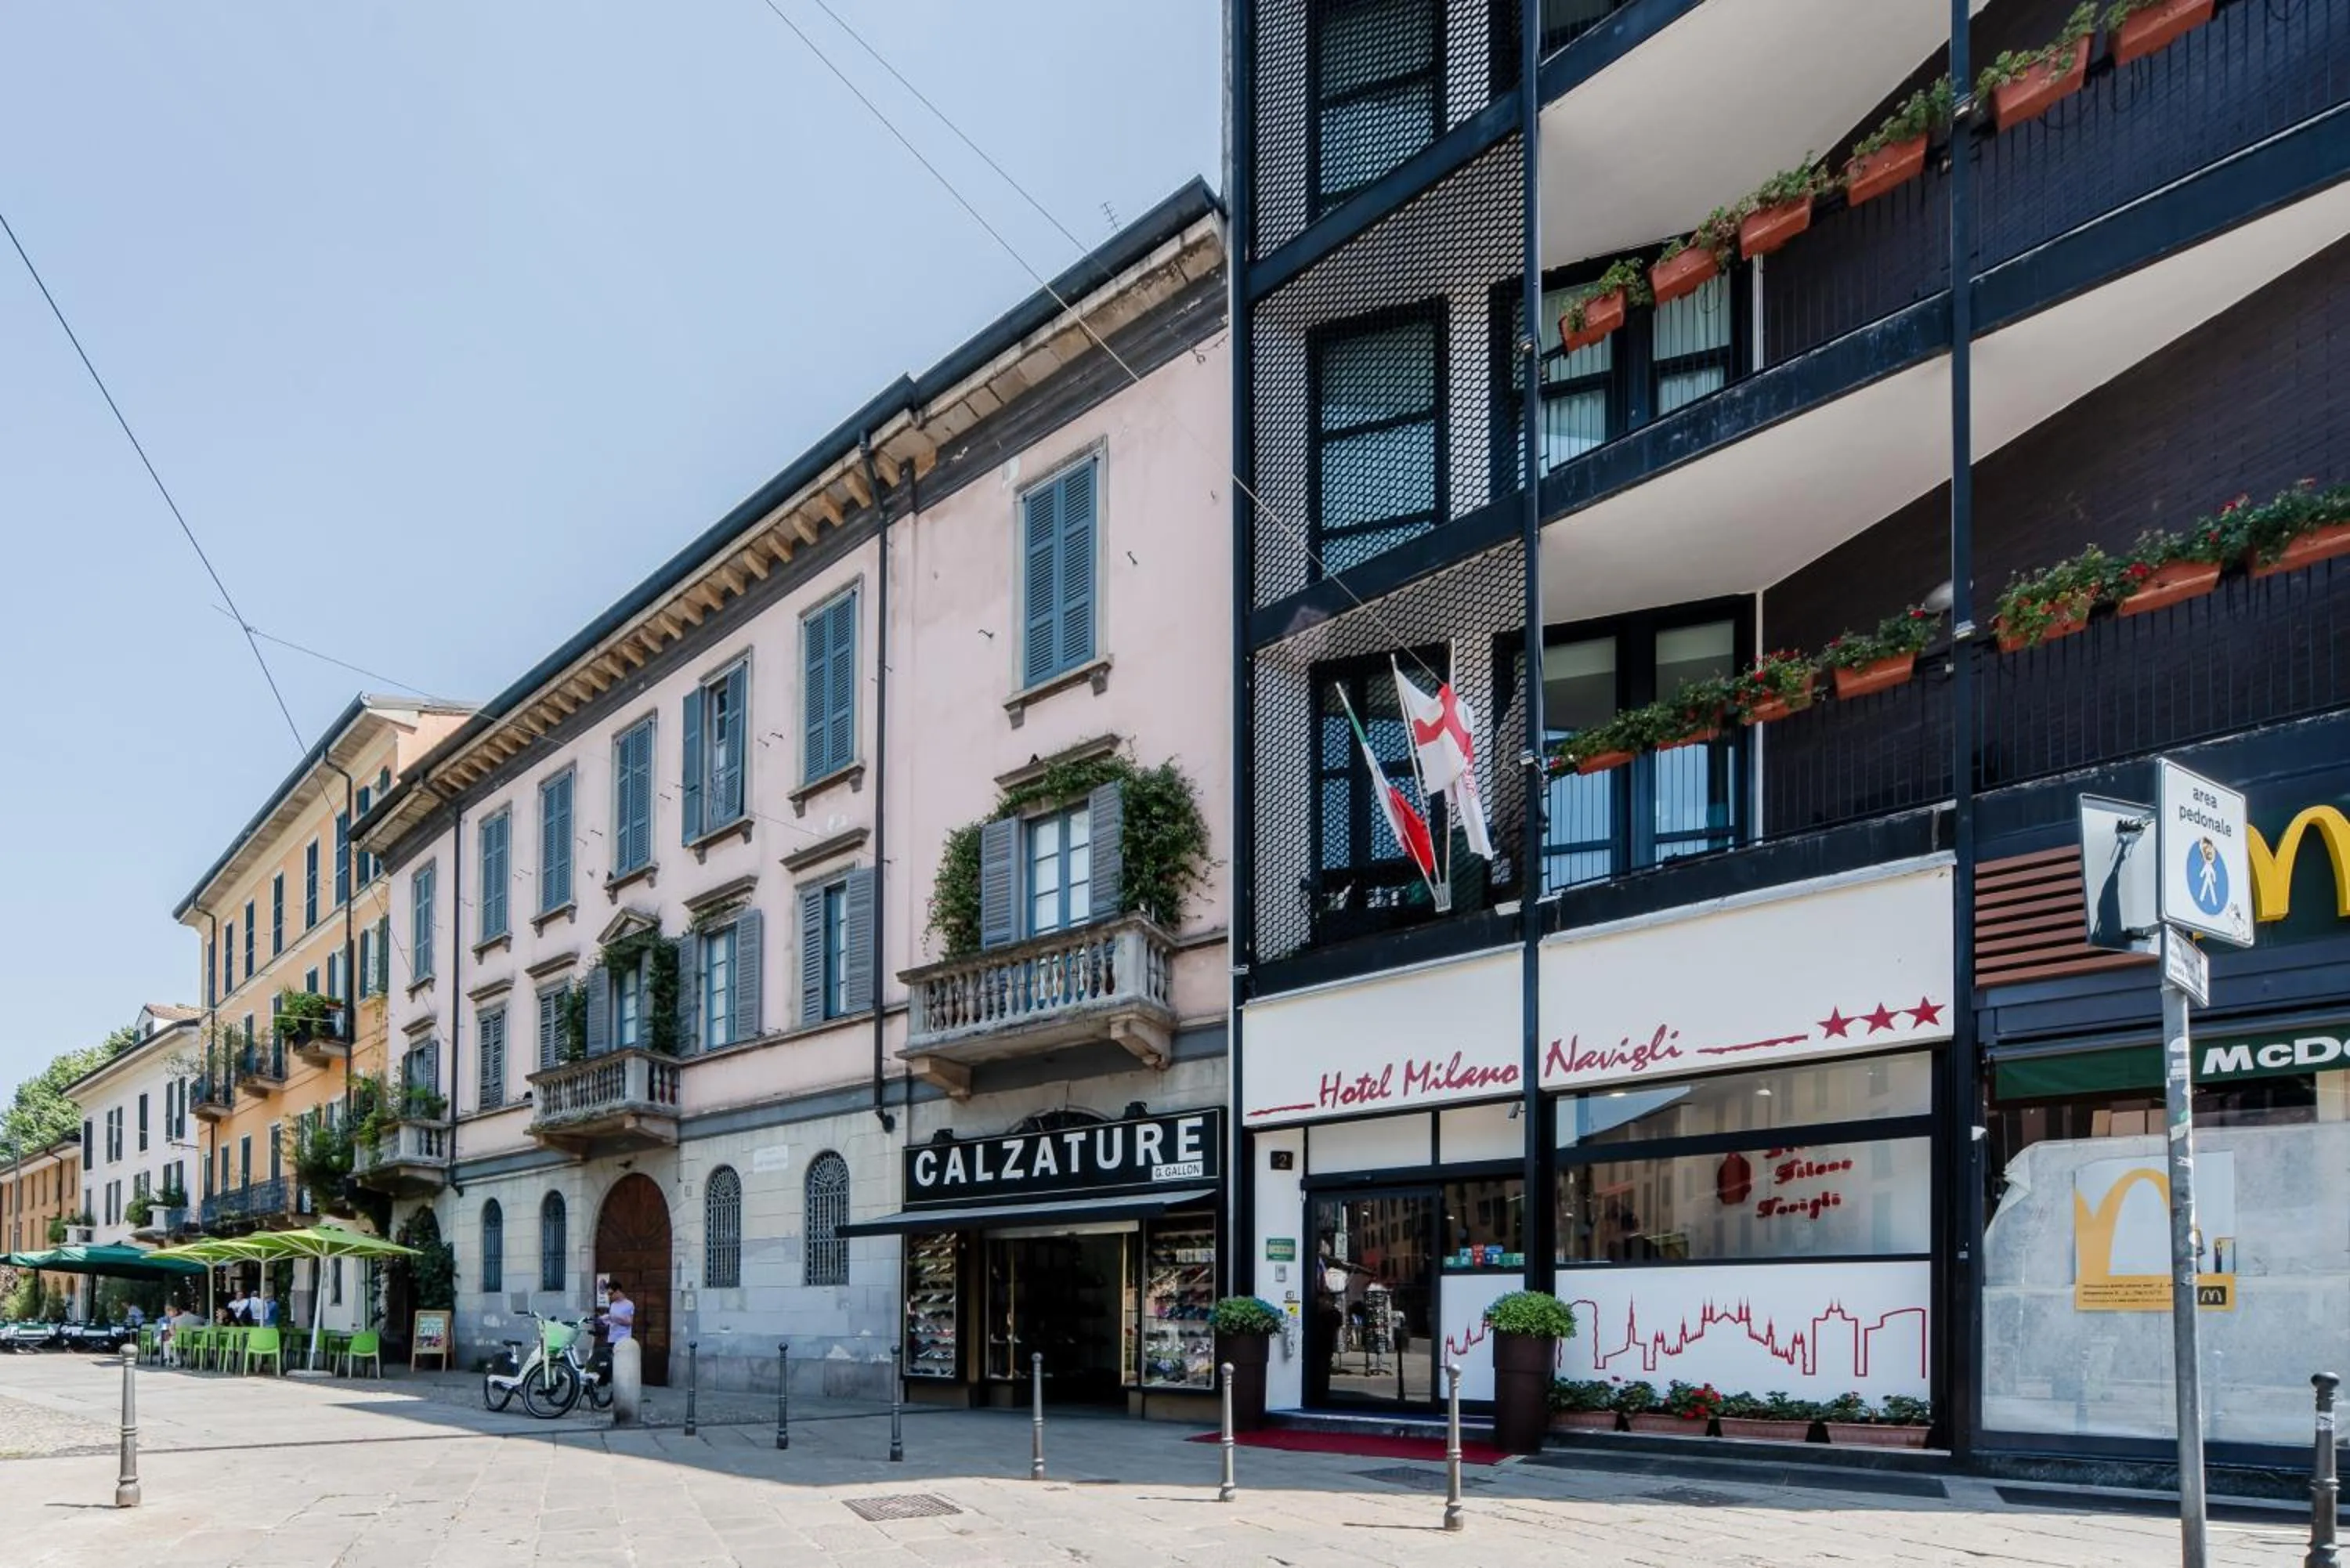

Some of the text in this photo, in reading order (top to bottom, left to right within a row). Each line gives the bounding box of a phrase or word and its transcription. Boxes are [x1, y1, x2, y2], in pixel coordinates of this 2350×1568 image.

[2193, 787, 2218, 808] area
[2179, 804, 2232, 837] pedonale
[1319, 1024, 1684, 1109] Hotel Milano Navigli
[2202, 1035, 2350, 1075] McD
[915, 1116, 1203, 1187] CALZATURE
[1166, 1164, 1200, 1176] GALLON
